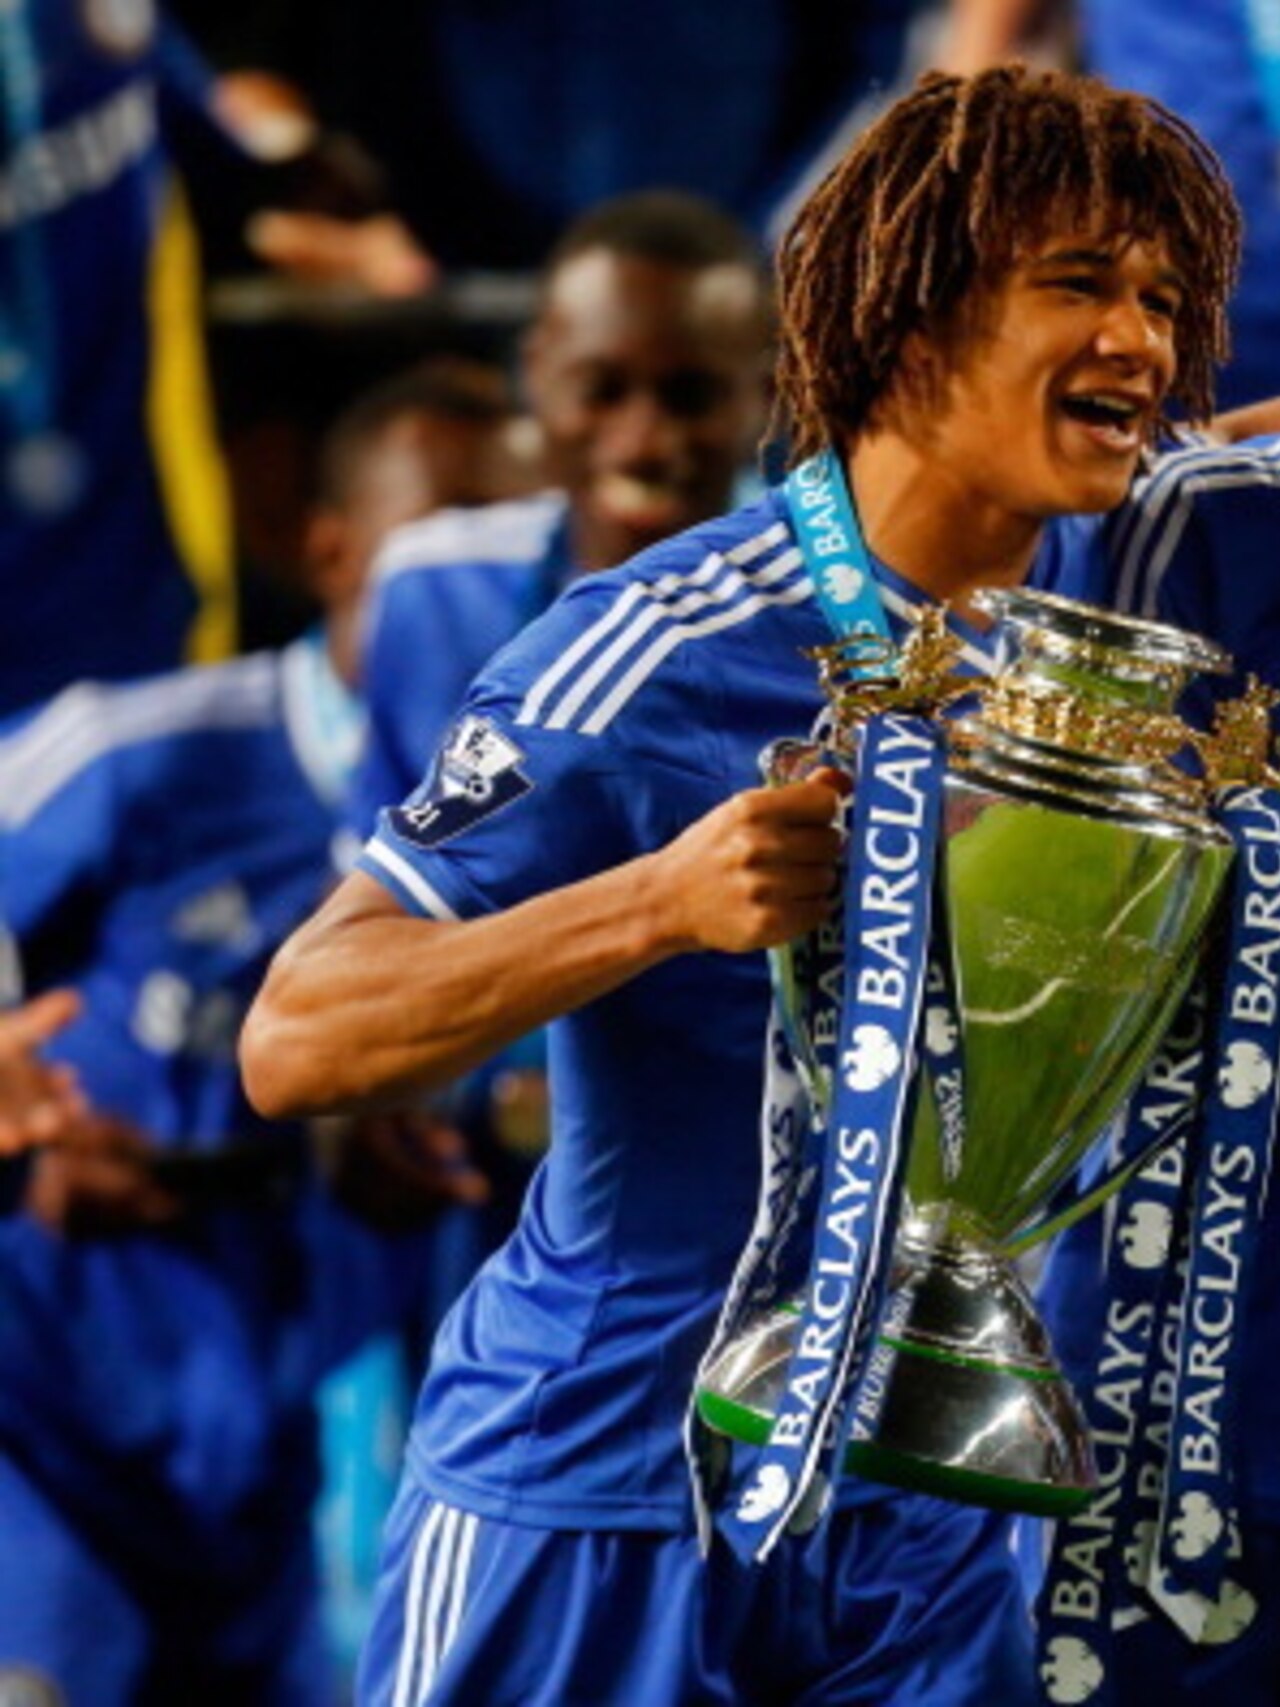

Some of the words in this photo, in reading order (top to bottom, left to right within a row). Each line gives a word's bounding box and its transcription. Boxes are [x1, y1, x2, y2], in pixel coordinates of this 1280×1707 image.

[856, 711, 937, 1011] BARCLAY
[770, 1127, 881, 1447] BARCLAYS
[1179, 1141, 1256, 1475] BARCLAYS
[1050, 1299, 1156, 1622] BARCLAYS
